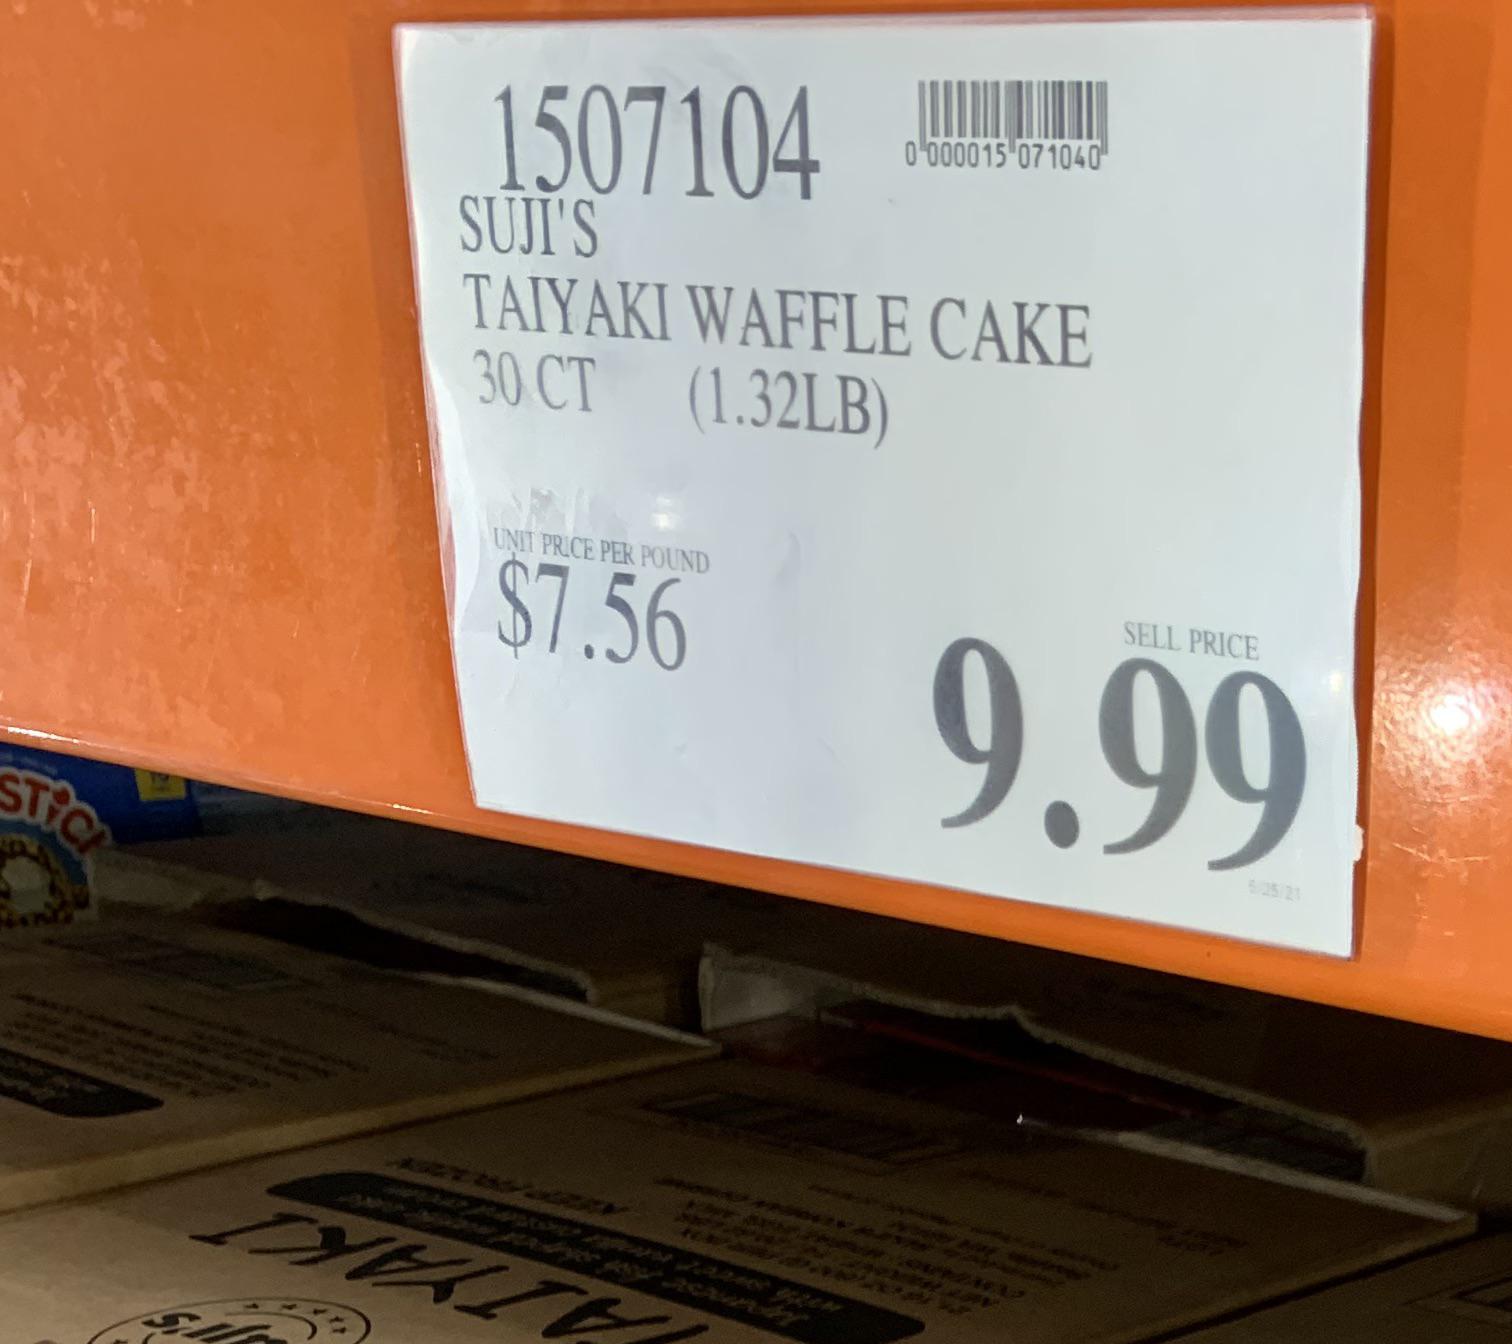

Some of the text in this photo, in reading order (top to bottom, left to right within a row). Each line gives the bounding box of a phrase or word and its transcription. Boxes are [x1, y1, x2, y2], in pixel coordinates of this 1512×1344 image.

[495, 84, 820, 199] 1507104
[460, 196, 598, 257] SUJI'S
[464, 273, 1092, 367] TAIYAKI WAFFLE CAKE
[473, 349, 889, 449] 30 CT (1.32LB)
[493, 527, 711, 574] UNIT PRICE PER POUND
[497, 553, 687, 671] $7.56
[1123, 620, 1259, 661] SELL PRICE
[933, 636, 1307, 871] 9.99
